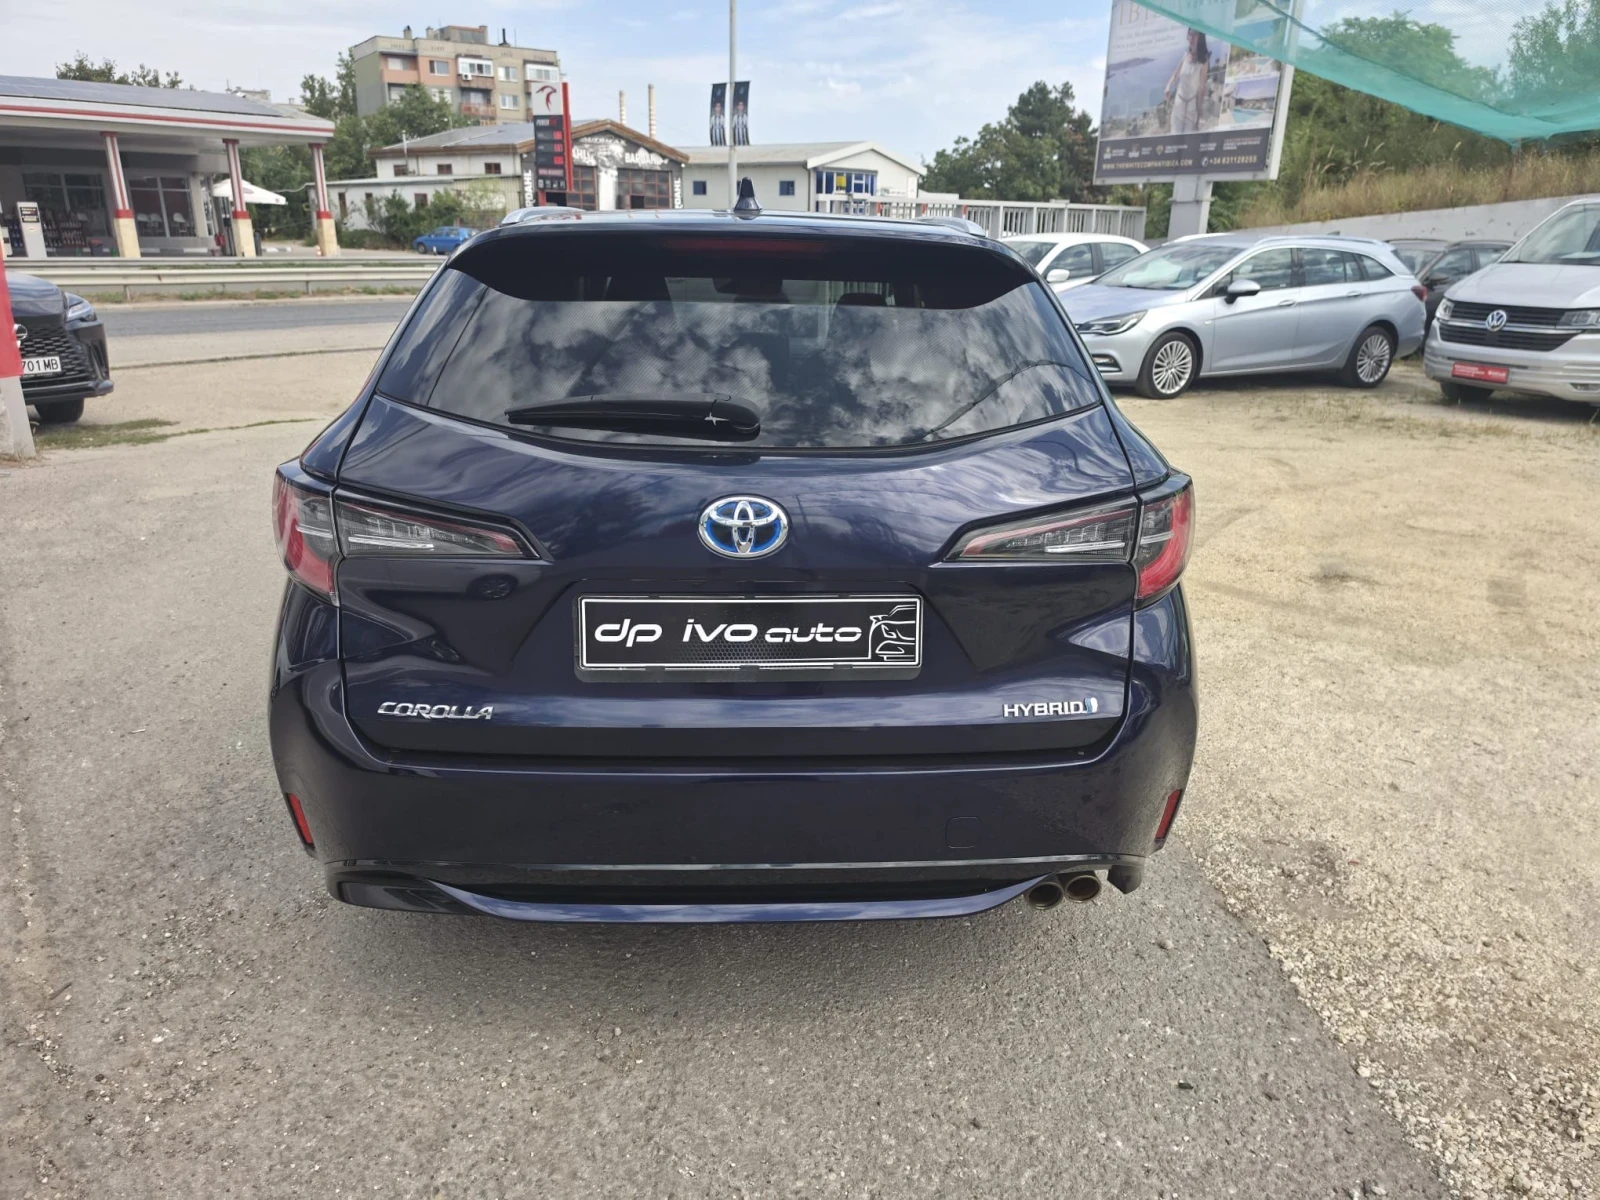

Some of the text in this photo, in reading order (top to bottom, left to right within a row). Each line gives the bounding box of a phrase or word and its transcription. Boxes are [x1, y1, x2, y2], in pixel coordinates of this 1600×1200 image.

[594, 618, 862, 648] dp ivo auto
[377, 701, 494, 720] COROLLA
[1003, 701, 1083, 717] HYBRID
